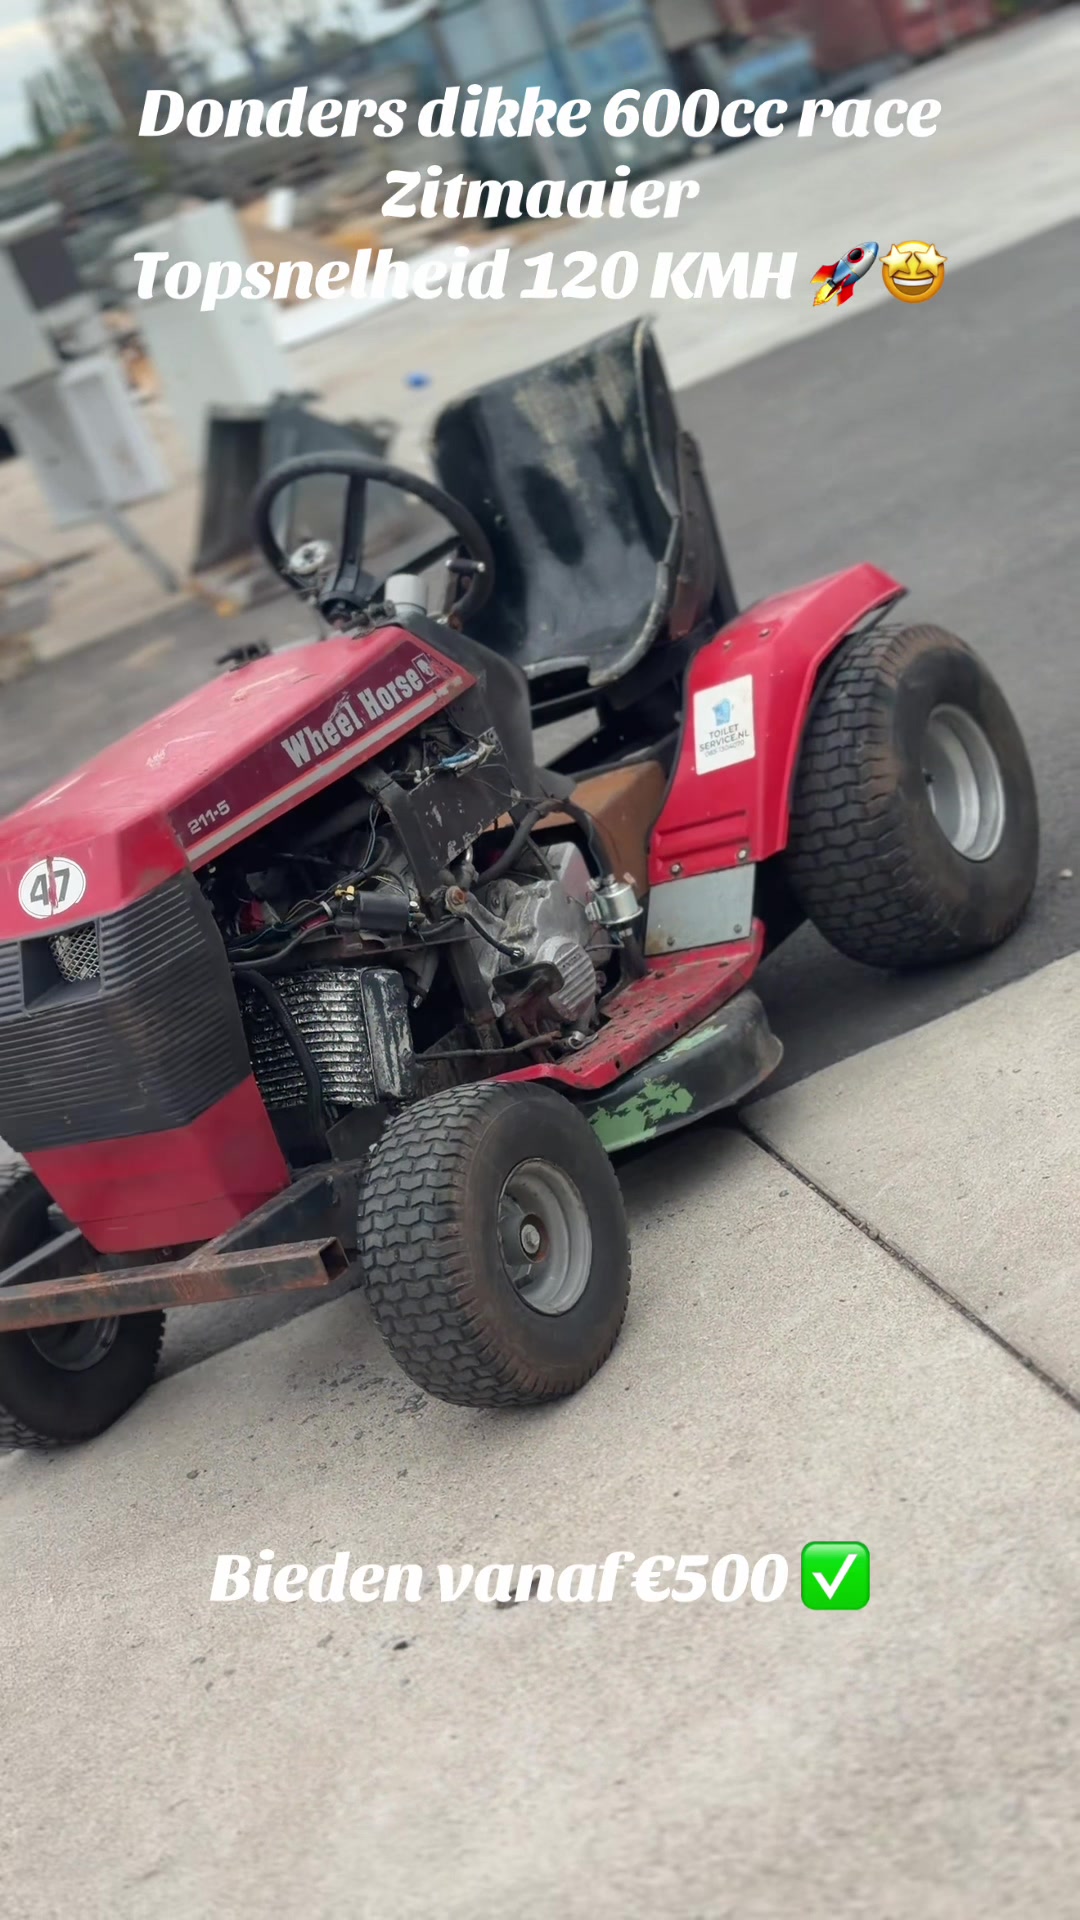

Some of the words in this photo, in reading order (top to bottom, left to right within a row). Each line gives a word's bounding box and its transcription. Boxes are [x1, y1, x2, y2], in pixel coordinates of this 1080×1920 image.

[281, 701, 363, 768] Wheel
[357, 668, 423, 721] Horse
[709, 723, 739, 739] TOILET
[699, 729, 750, 752] SERVICE.NL
[187, 800, 230, 835] 211-5
[30, 868, 70, 906] 47
